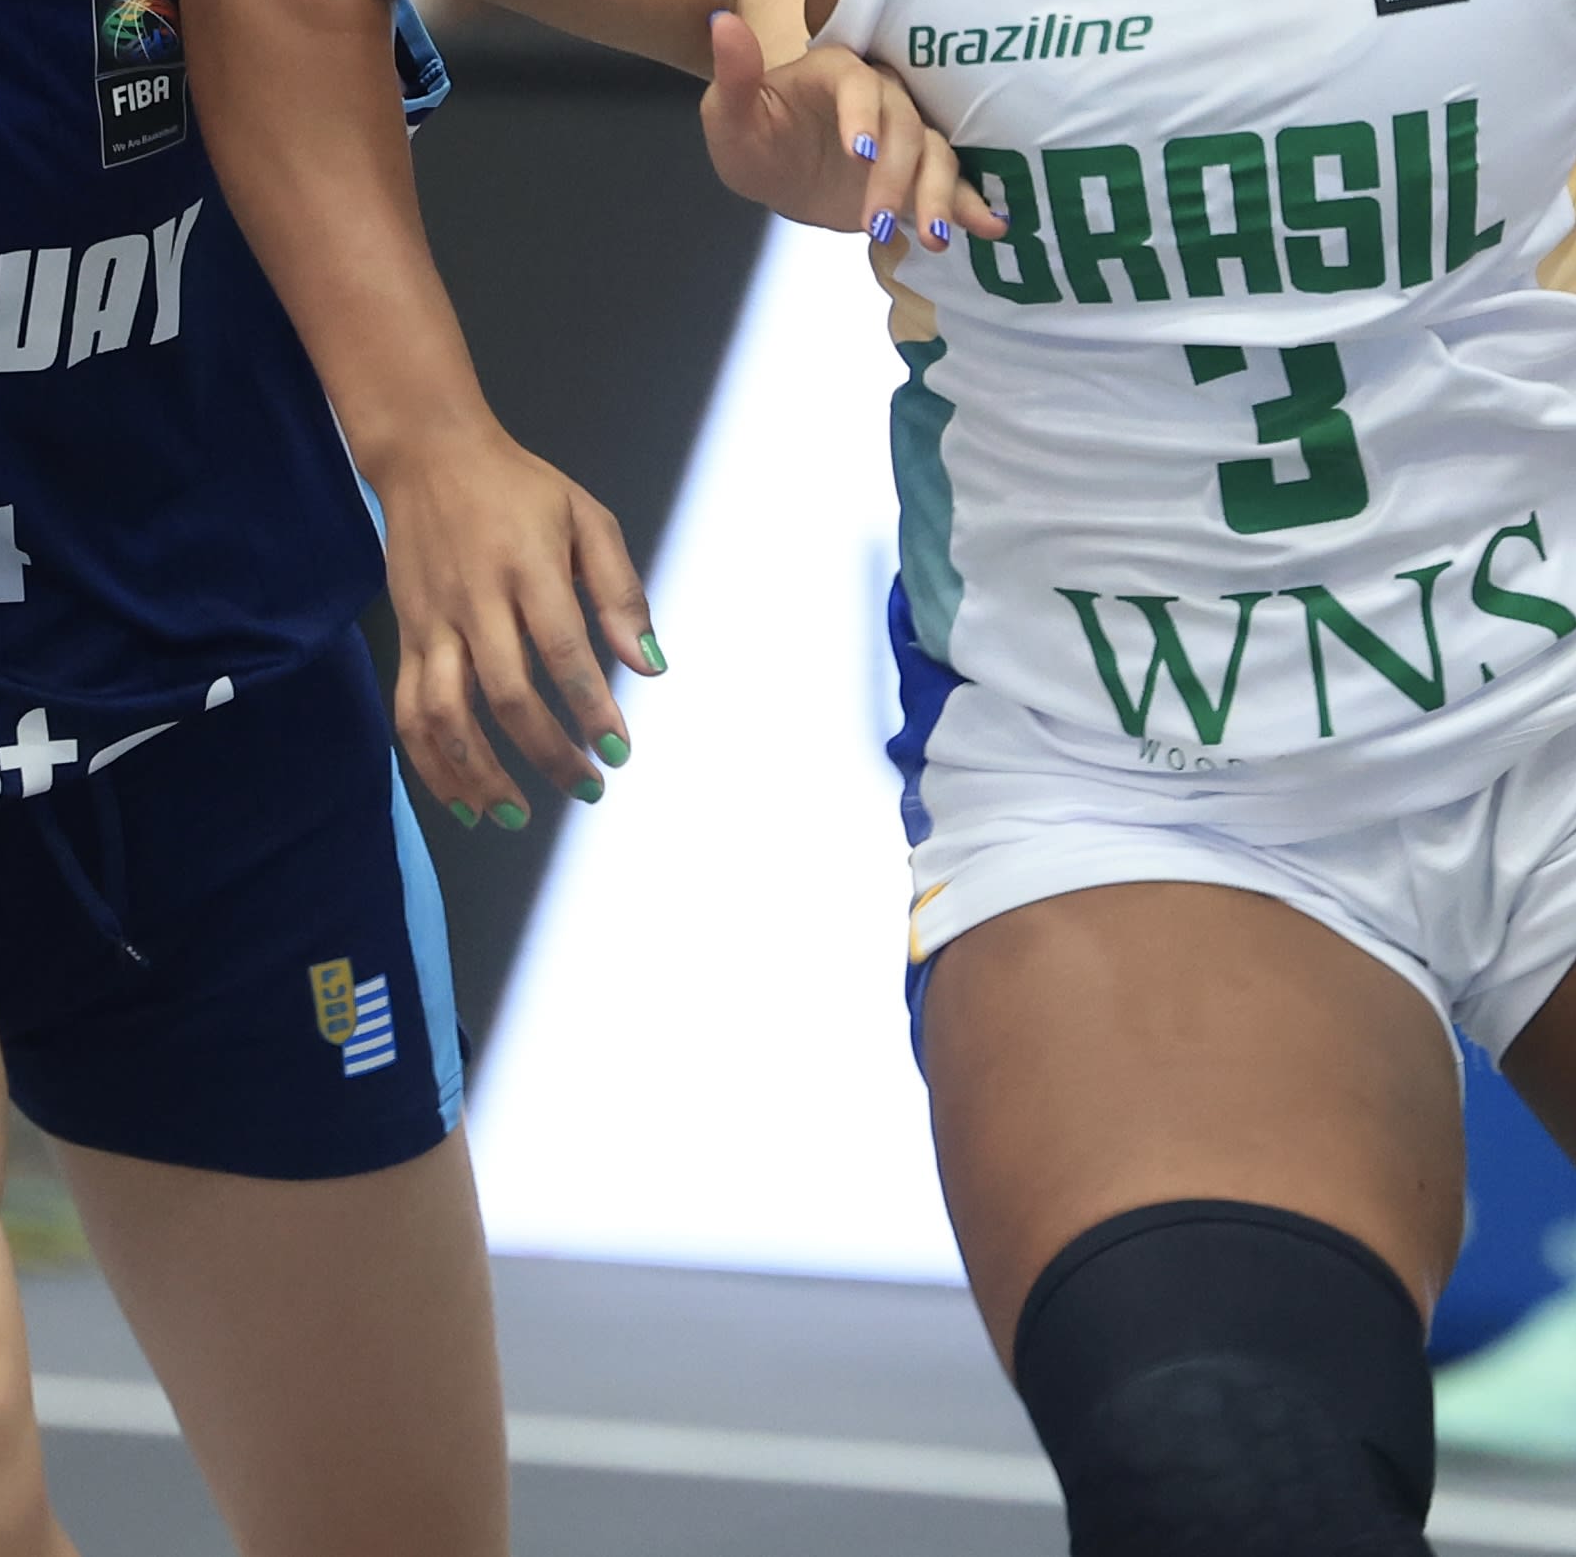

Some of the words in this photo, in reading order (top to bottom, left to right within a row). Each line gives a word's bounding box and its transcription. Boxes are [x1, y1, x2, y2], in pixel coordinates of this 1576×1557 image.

[112, 75, 170, 117] FIBA
[909, 12, 1155, 69] Braziline
[949, 98, 1506, 306] BRASIL
[1184, 342, 1370, 535] 3
